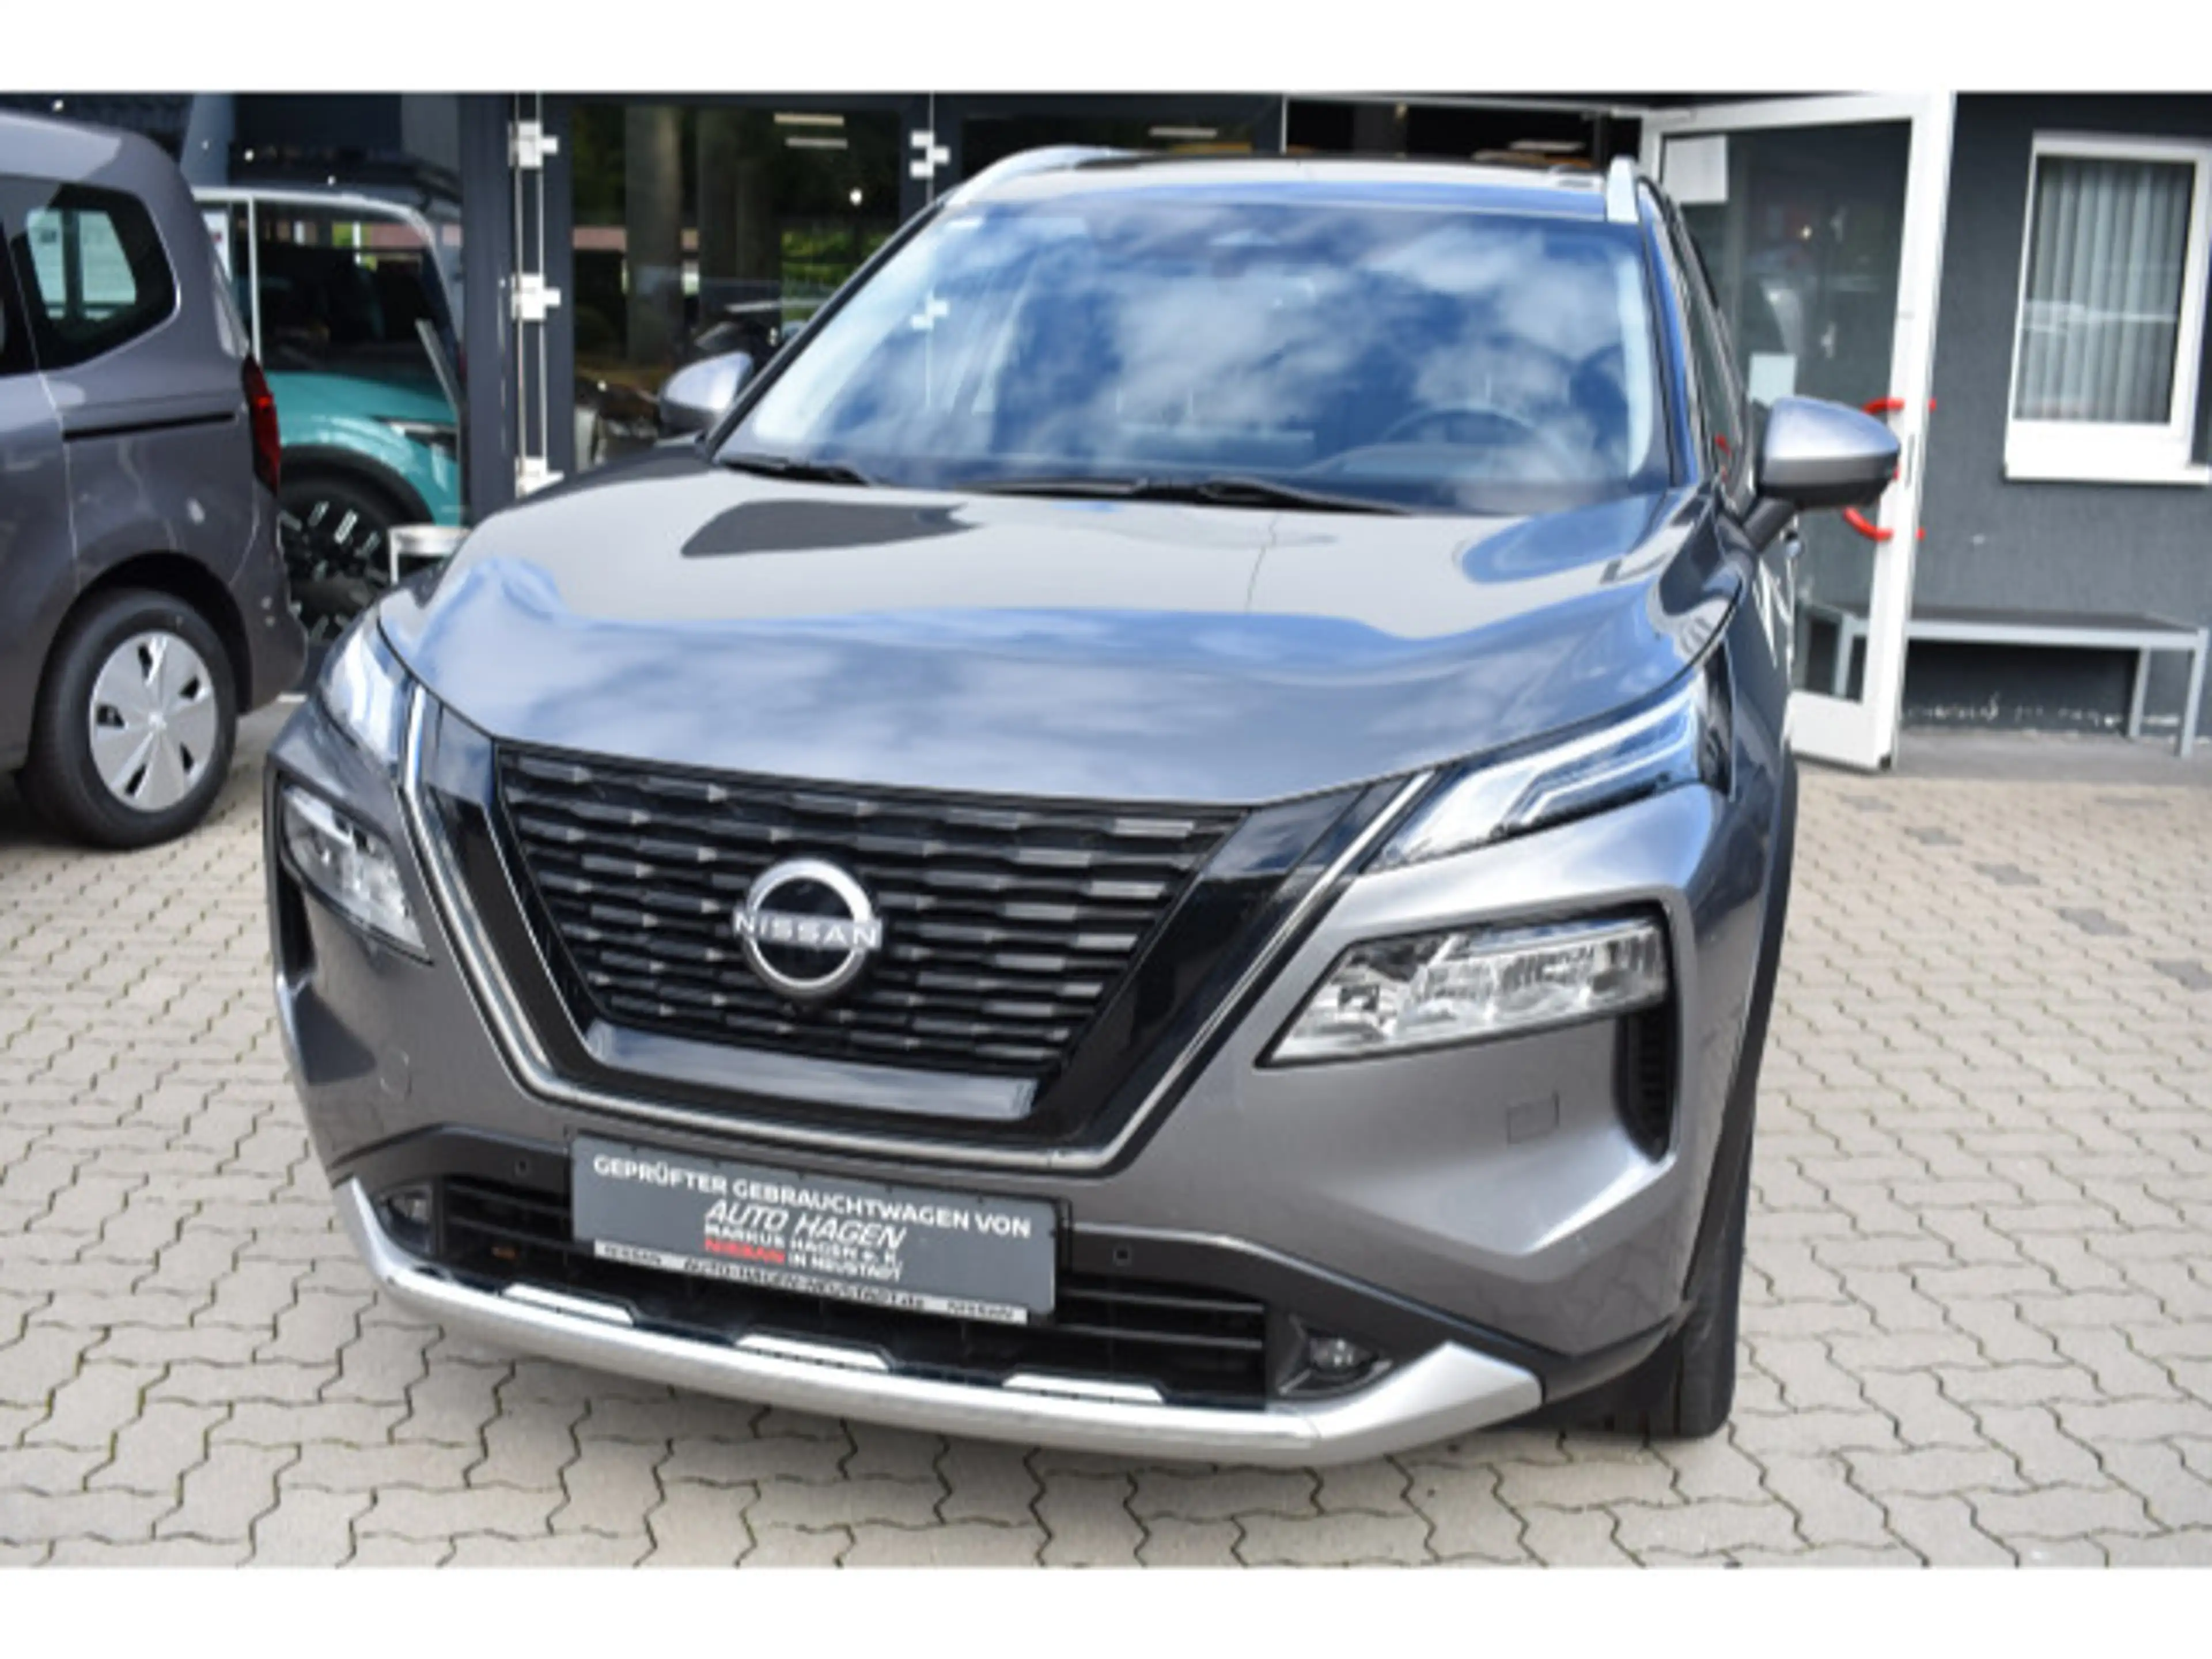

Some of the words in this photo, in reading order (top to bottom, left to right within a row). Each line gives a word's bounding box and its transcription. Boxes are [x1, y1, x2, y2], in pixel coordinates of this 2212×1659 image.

[734, 911, 877, 948] NISSAN
[593, 1153, 728, 1195] GEPRÜFTER
[732, 1177, 970, 1231] GEBRAUCHTWAGEN
[974, 1211, 1031, 1238] VON
[705, 1198, 790, 1233] AUTO
[790, 1212, 907, 1251] HAGEN
